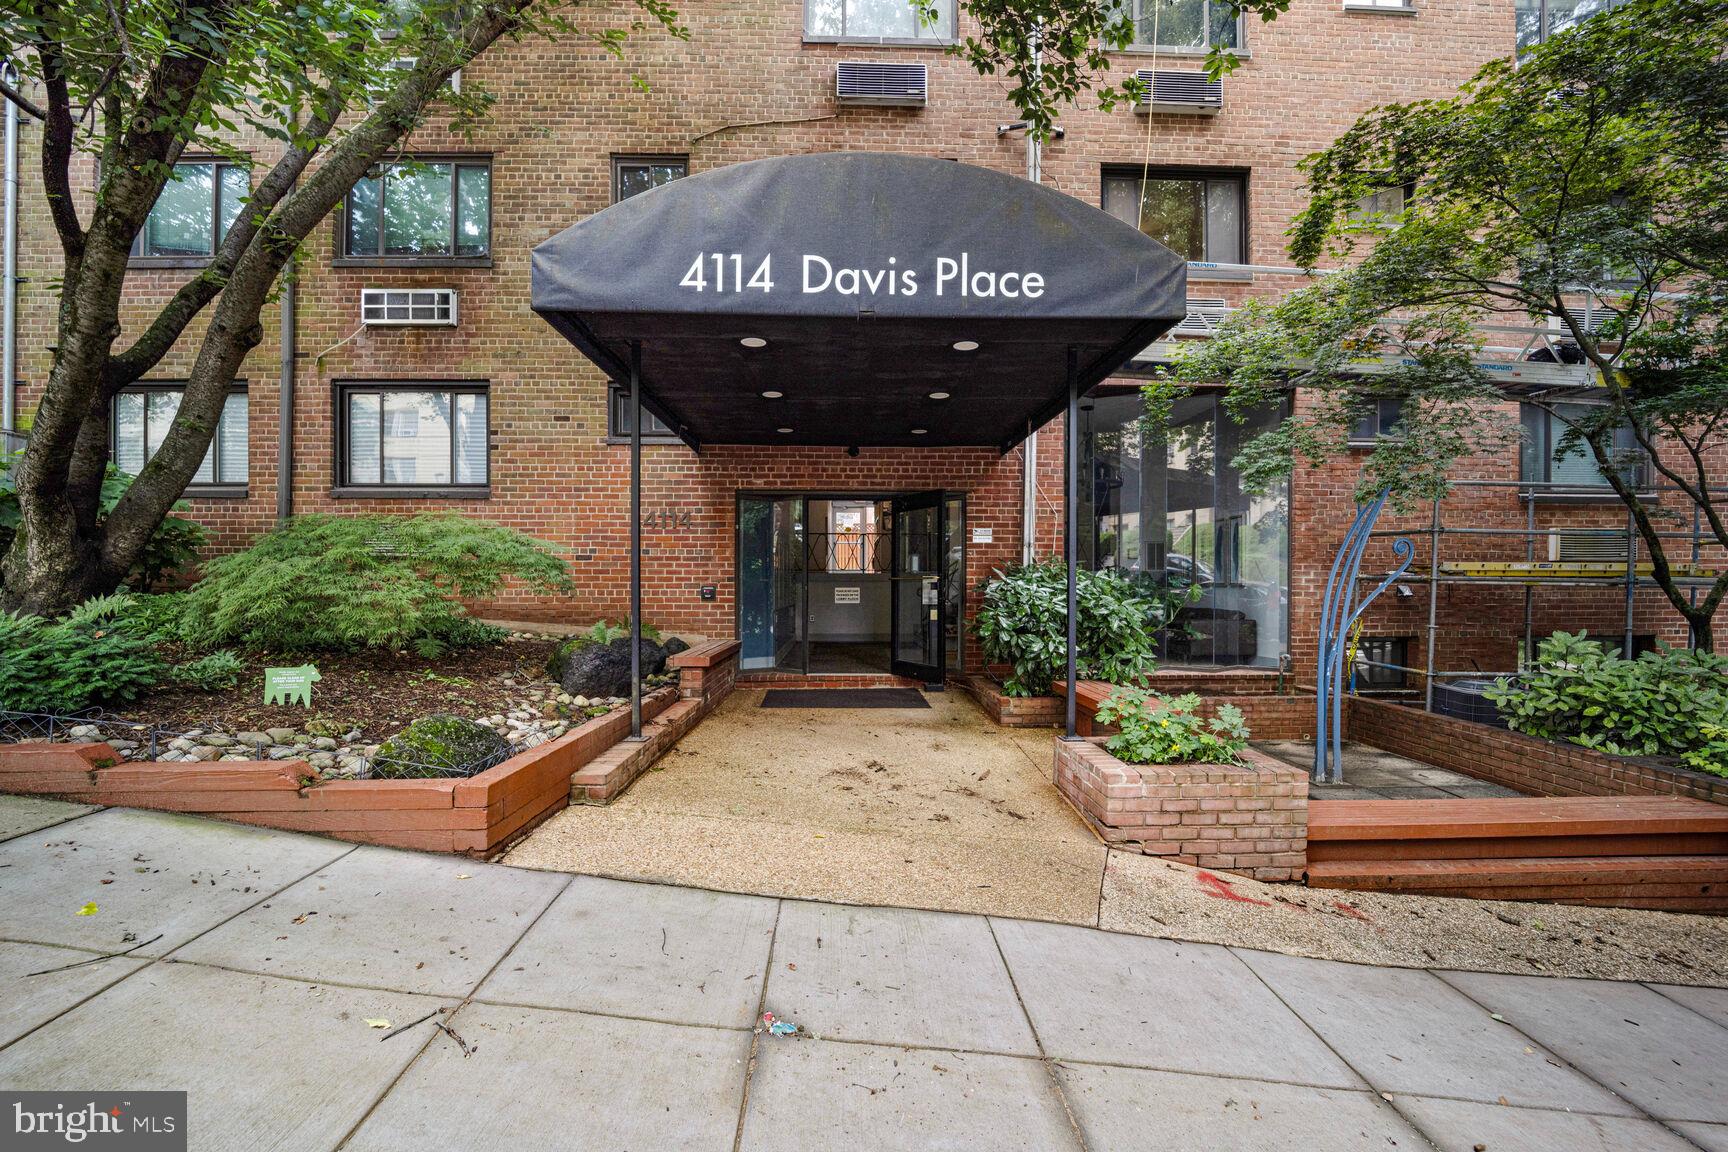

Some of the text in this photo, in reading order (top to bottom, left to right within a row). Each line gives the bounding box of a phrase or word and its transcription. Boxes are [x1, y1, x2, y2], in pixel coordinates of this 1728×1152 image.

[678, 251, 1045, 298] 4114 Davis Place
[643, 511, 693, 529] 4114
